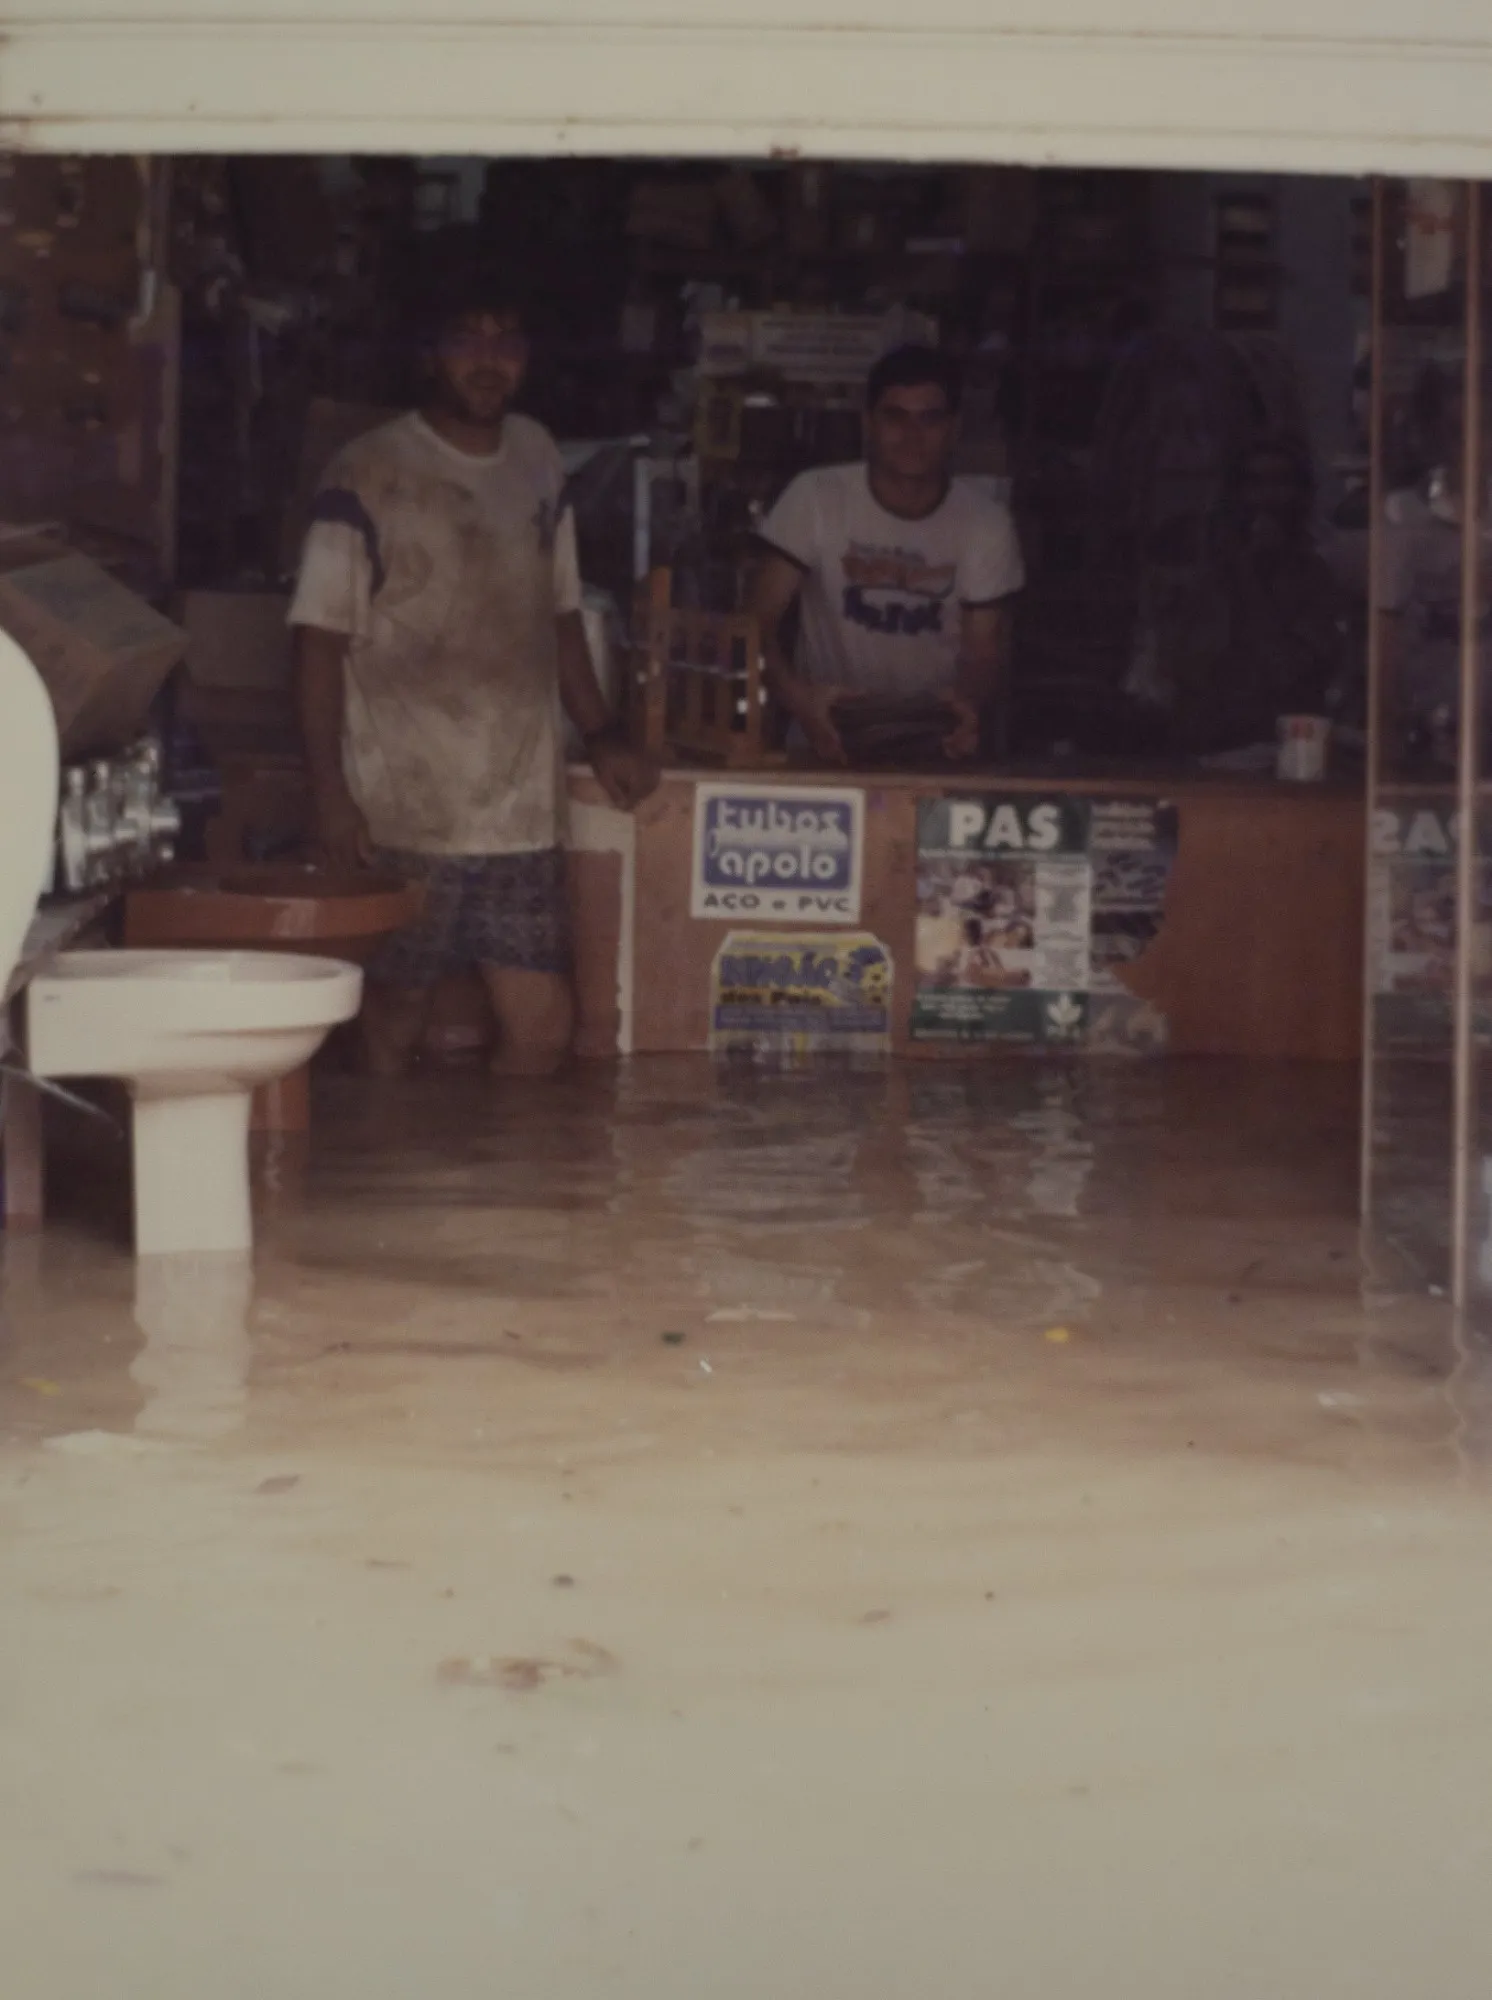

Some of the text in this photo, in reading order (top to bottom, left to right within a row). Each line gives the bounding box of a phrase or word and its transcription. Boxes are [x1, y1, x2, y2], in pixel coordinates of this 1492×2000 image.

[717, 799, 840, 832] tubos
[950, 803, 1061, 848] PAS
[718, 845, 838, 884] apolo
[798, 896, 851, 913] PVC
